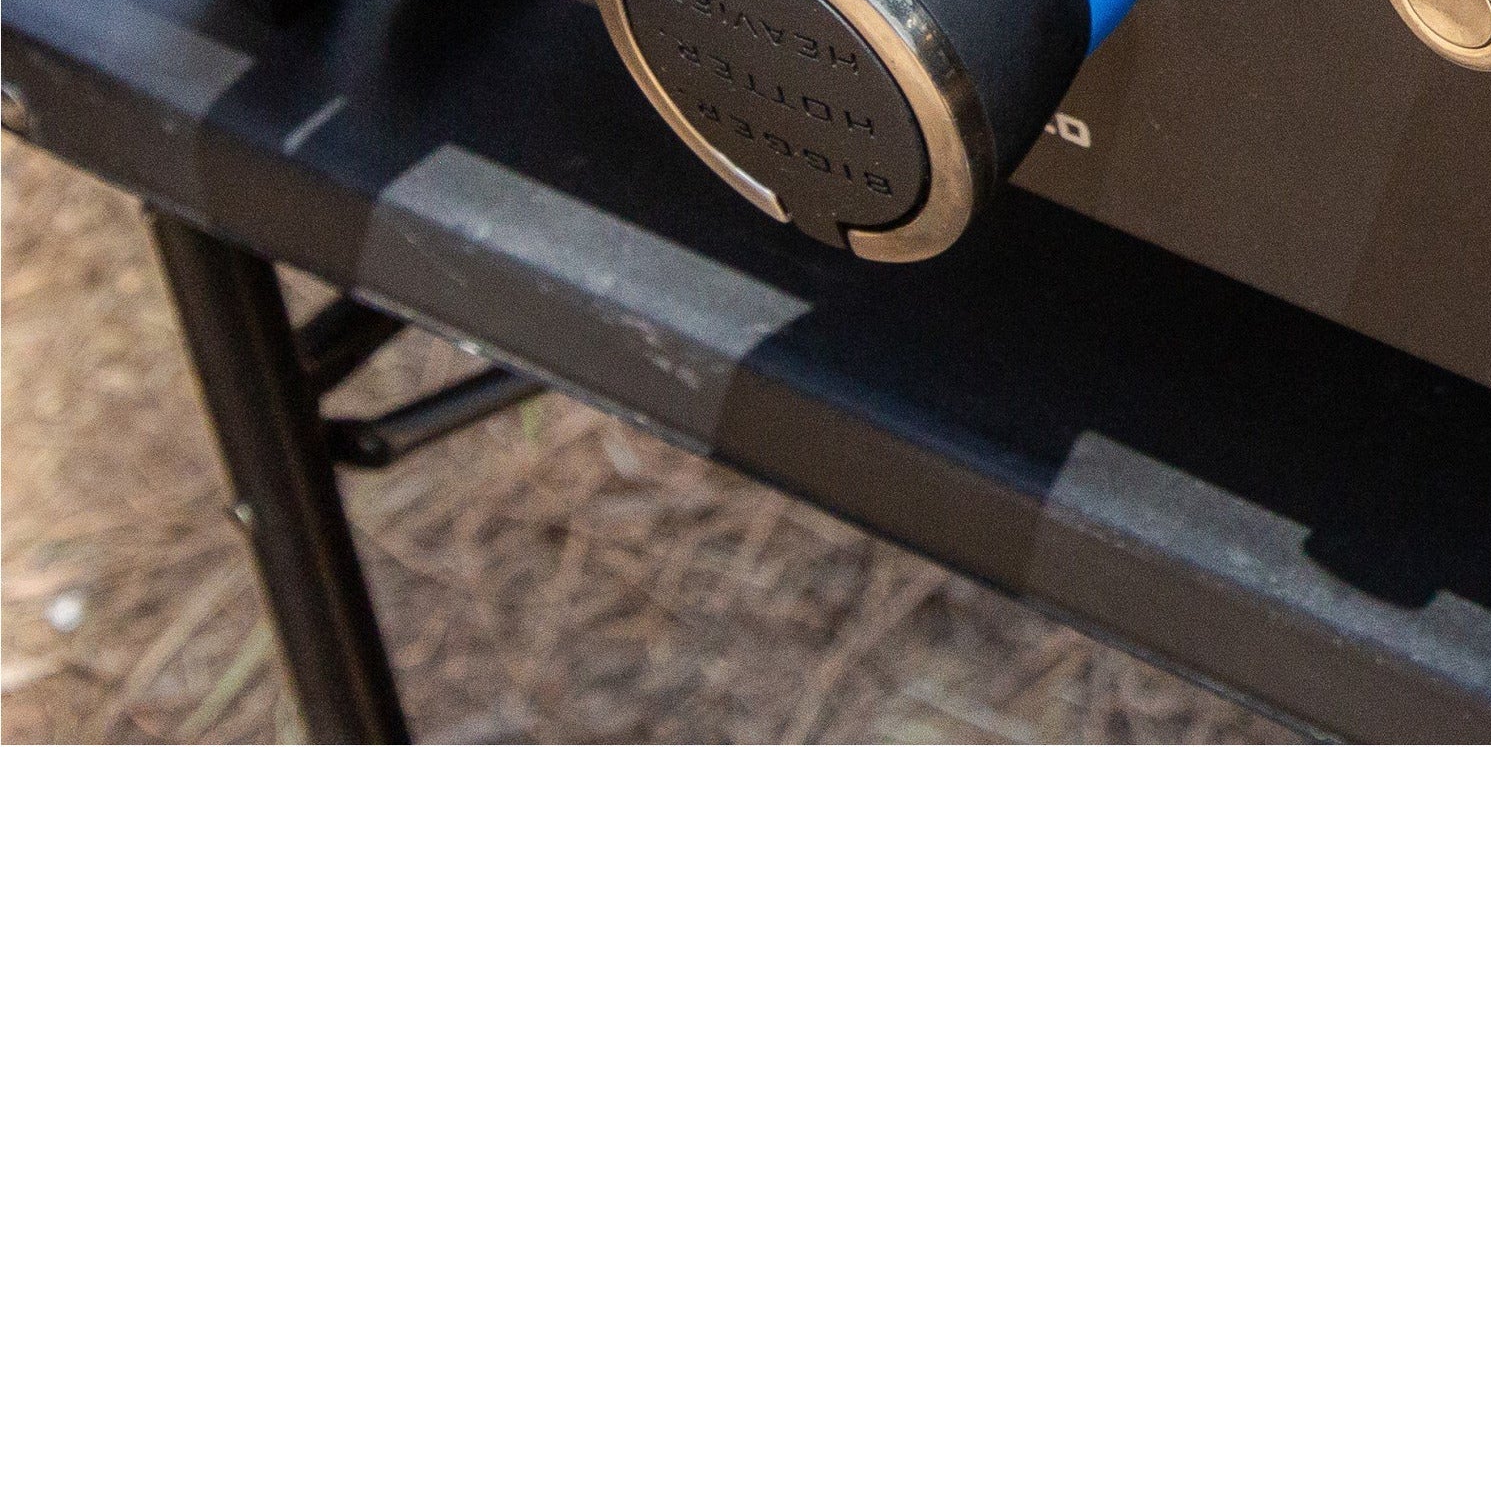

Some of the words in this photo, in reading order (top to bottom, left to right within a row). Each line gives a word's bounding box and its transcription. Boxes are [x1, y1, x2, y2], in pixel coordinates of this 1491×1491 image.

[660, 29, 875, 139] HOTTER.
[1044, 110, 1091, 148] O
[676, 86, 892, 197] BIGGER.
